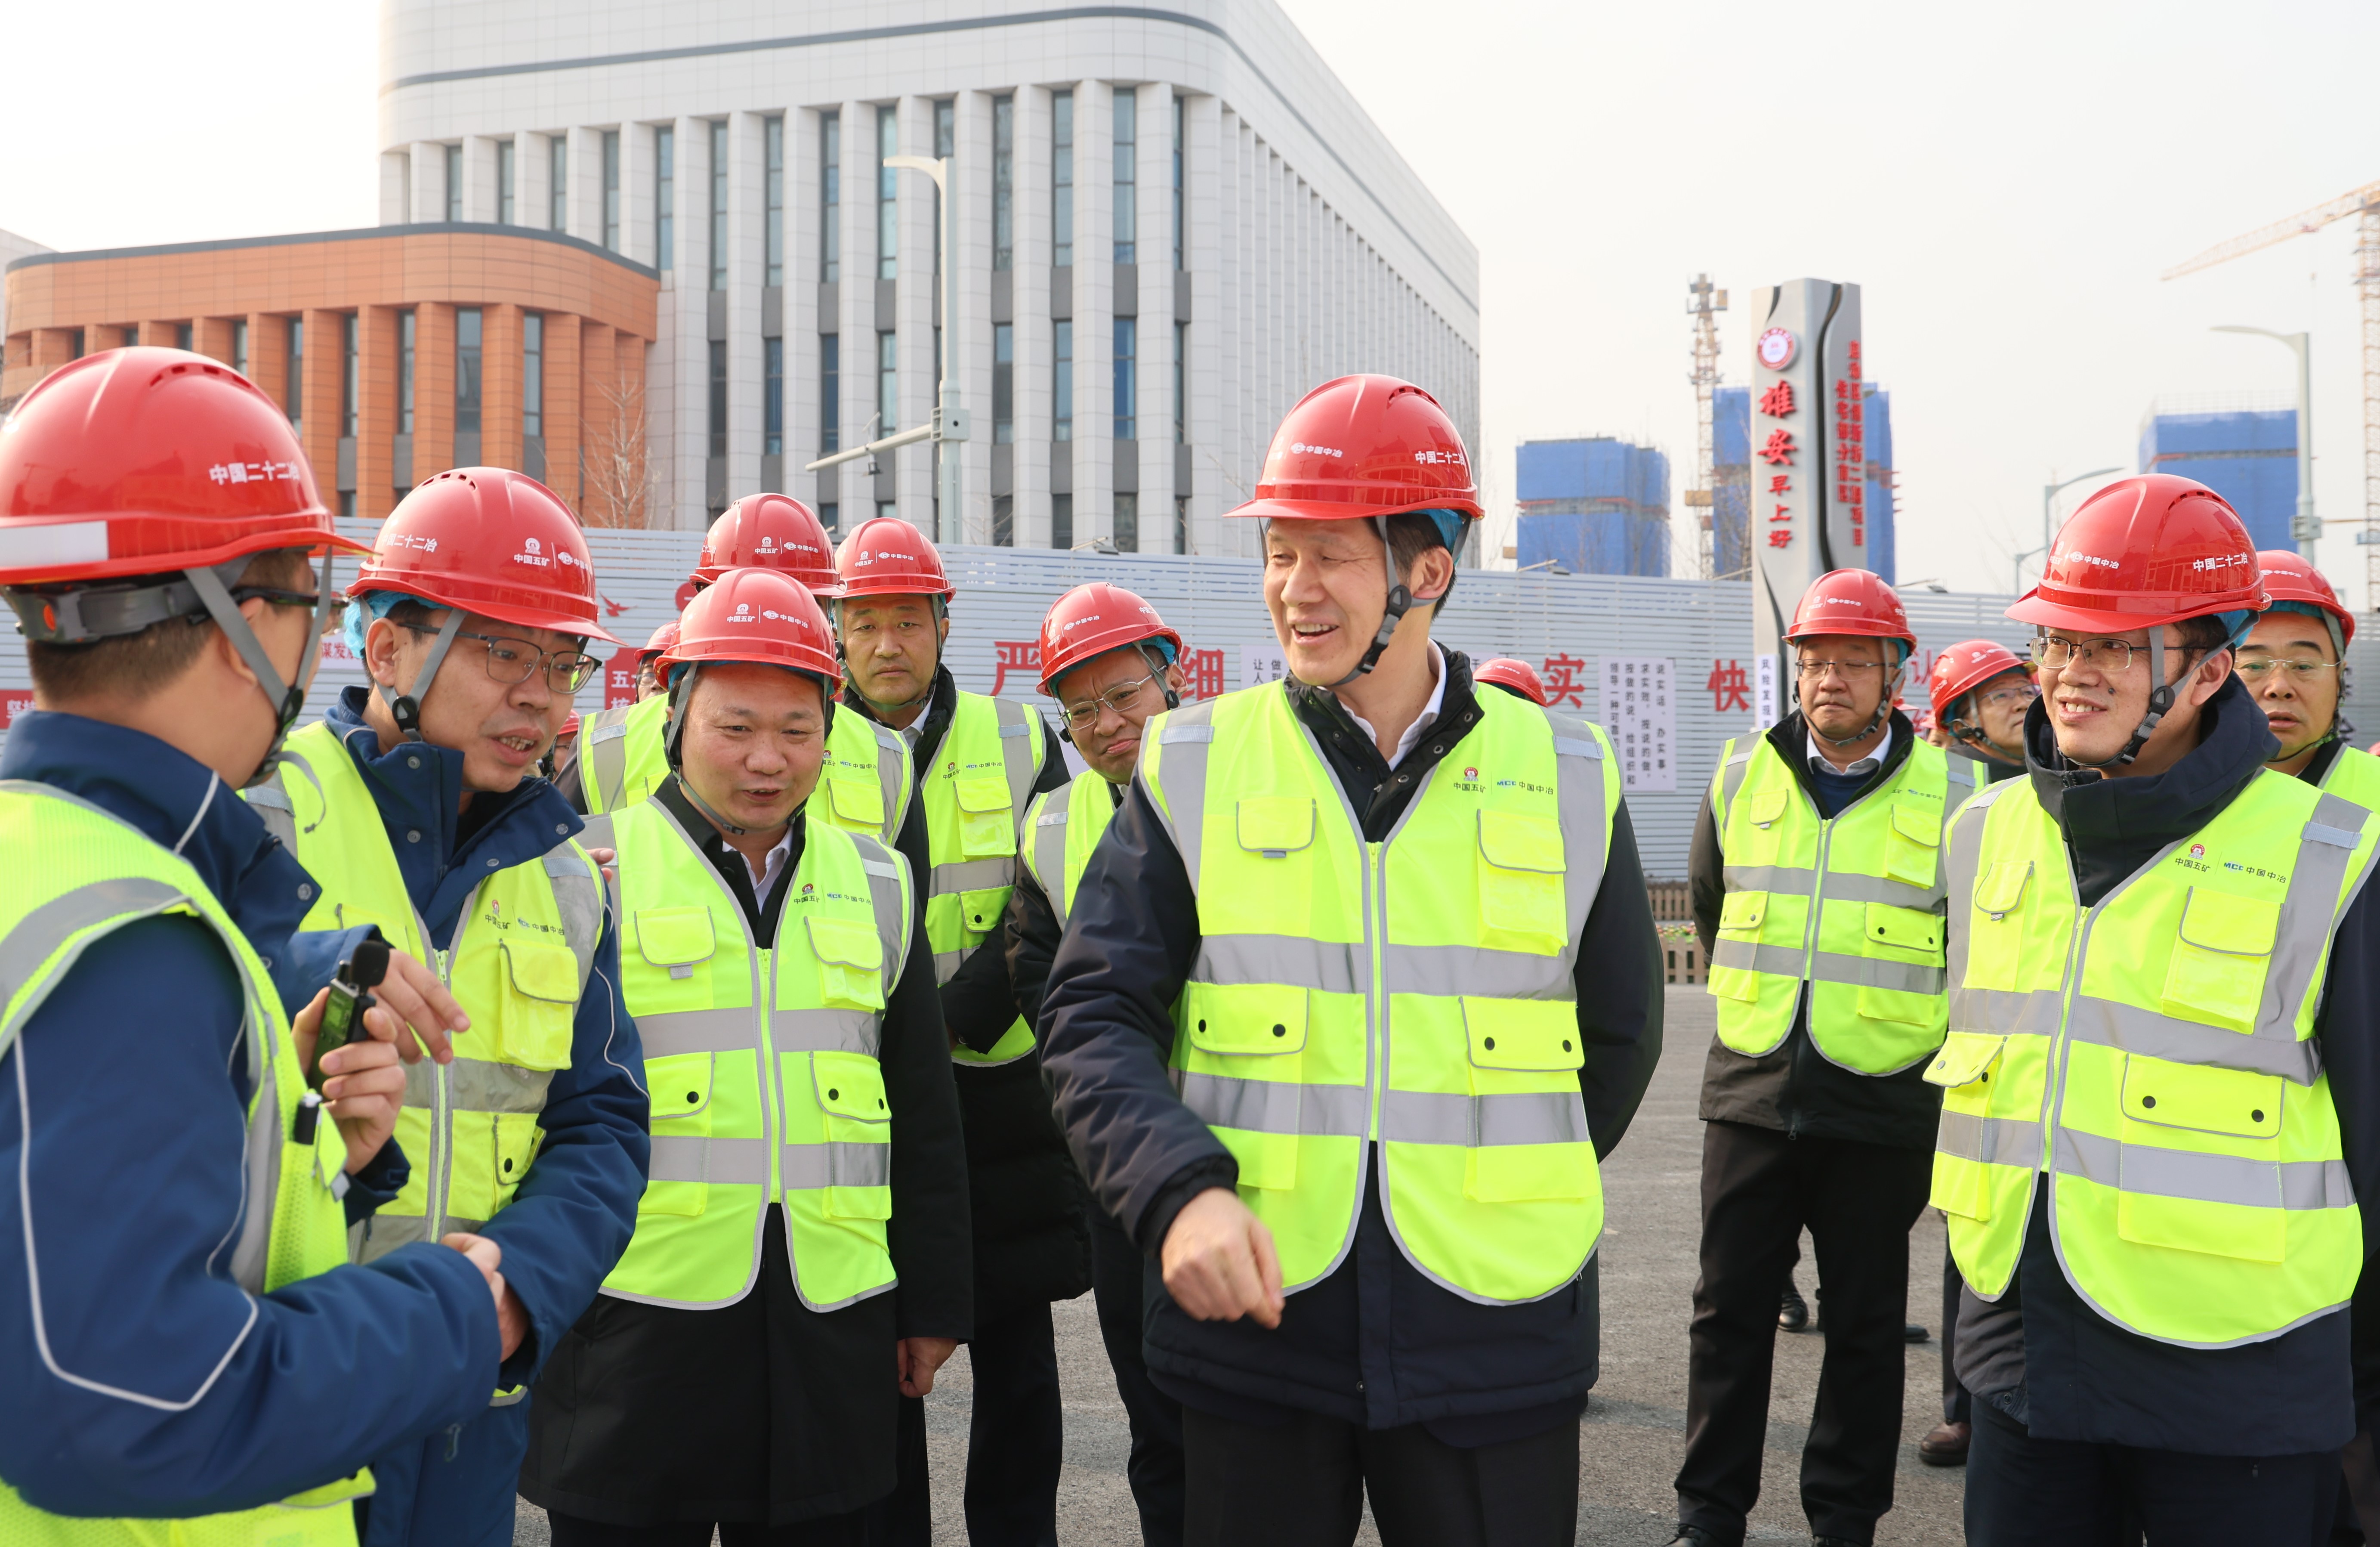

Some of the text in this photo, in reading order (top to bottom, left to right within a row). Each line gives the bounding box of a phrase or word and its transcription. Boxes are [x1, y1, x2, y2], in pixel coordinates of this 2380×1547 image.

[1306, 445, 1343, 458] 中国中冶
[1414, 451, 1466, 466] 中国二十二冶
[1757, 379, 1797, 548] 雄安早上好
[381, 533, 438, 553] 中国二十二冶
[797, 544, 818, 553] 中国中冶
[514, 553, 550, 567] 中国五矿
[574, 558, 590, 571] 中国中
[2084, 555, 2120, 569] 中国中冶
[2193, 552, 2248, 572] 中国二十二冶
[780, 614, 809, 629] 中国中冶
[1075, 615, 1100, 625] 中国中冶
[321, 642, 354, 659] 谋发
[989, 639, 1042, 696] 严
[1180, 645, 1225, 702] 细
[1253, 659, 1263, 684] 让人
[1543, 652, 1586, 709] 实
[1707, 659, 1750, 712] 快
[822, 759, 836, 767] 国五矿
[942, 769, 961, 780] 中国五矿
[1453, 782, 1487, 793] 中国五矿
[1519, 781, 1554, 791] 中国中冶
[2175, 857, 2287, 884] 中国五矿 MCC 中国中冶
[844, 894, 871, 905] 中国中冶
[485, 914, 510, 930] 中国五矿
[532, 923, 565, 936] 中国中冶
